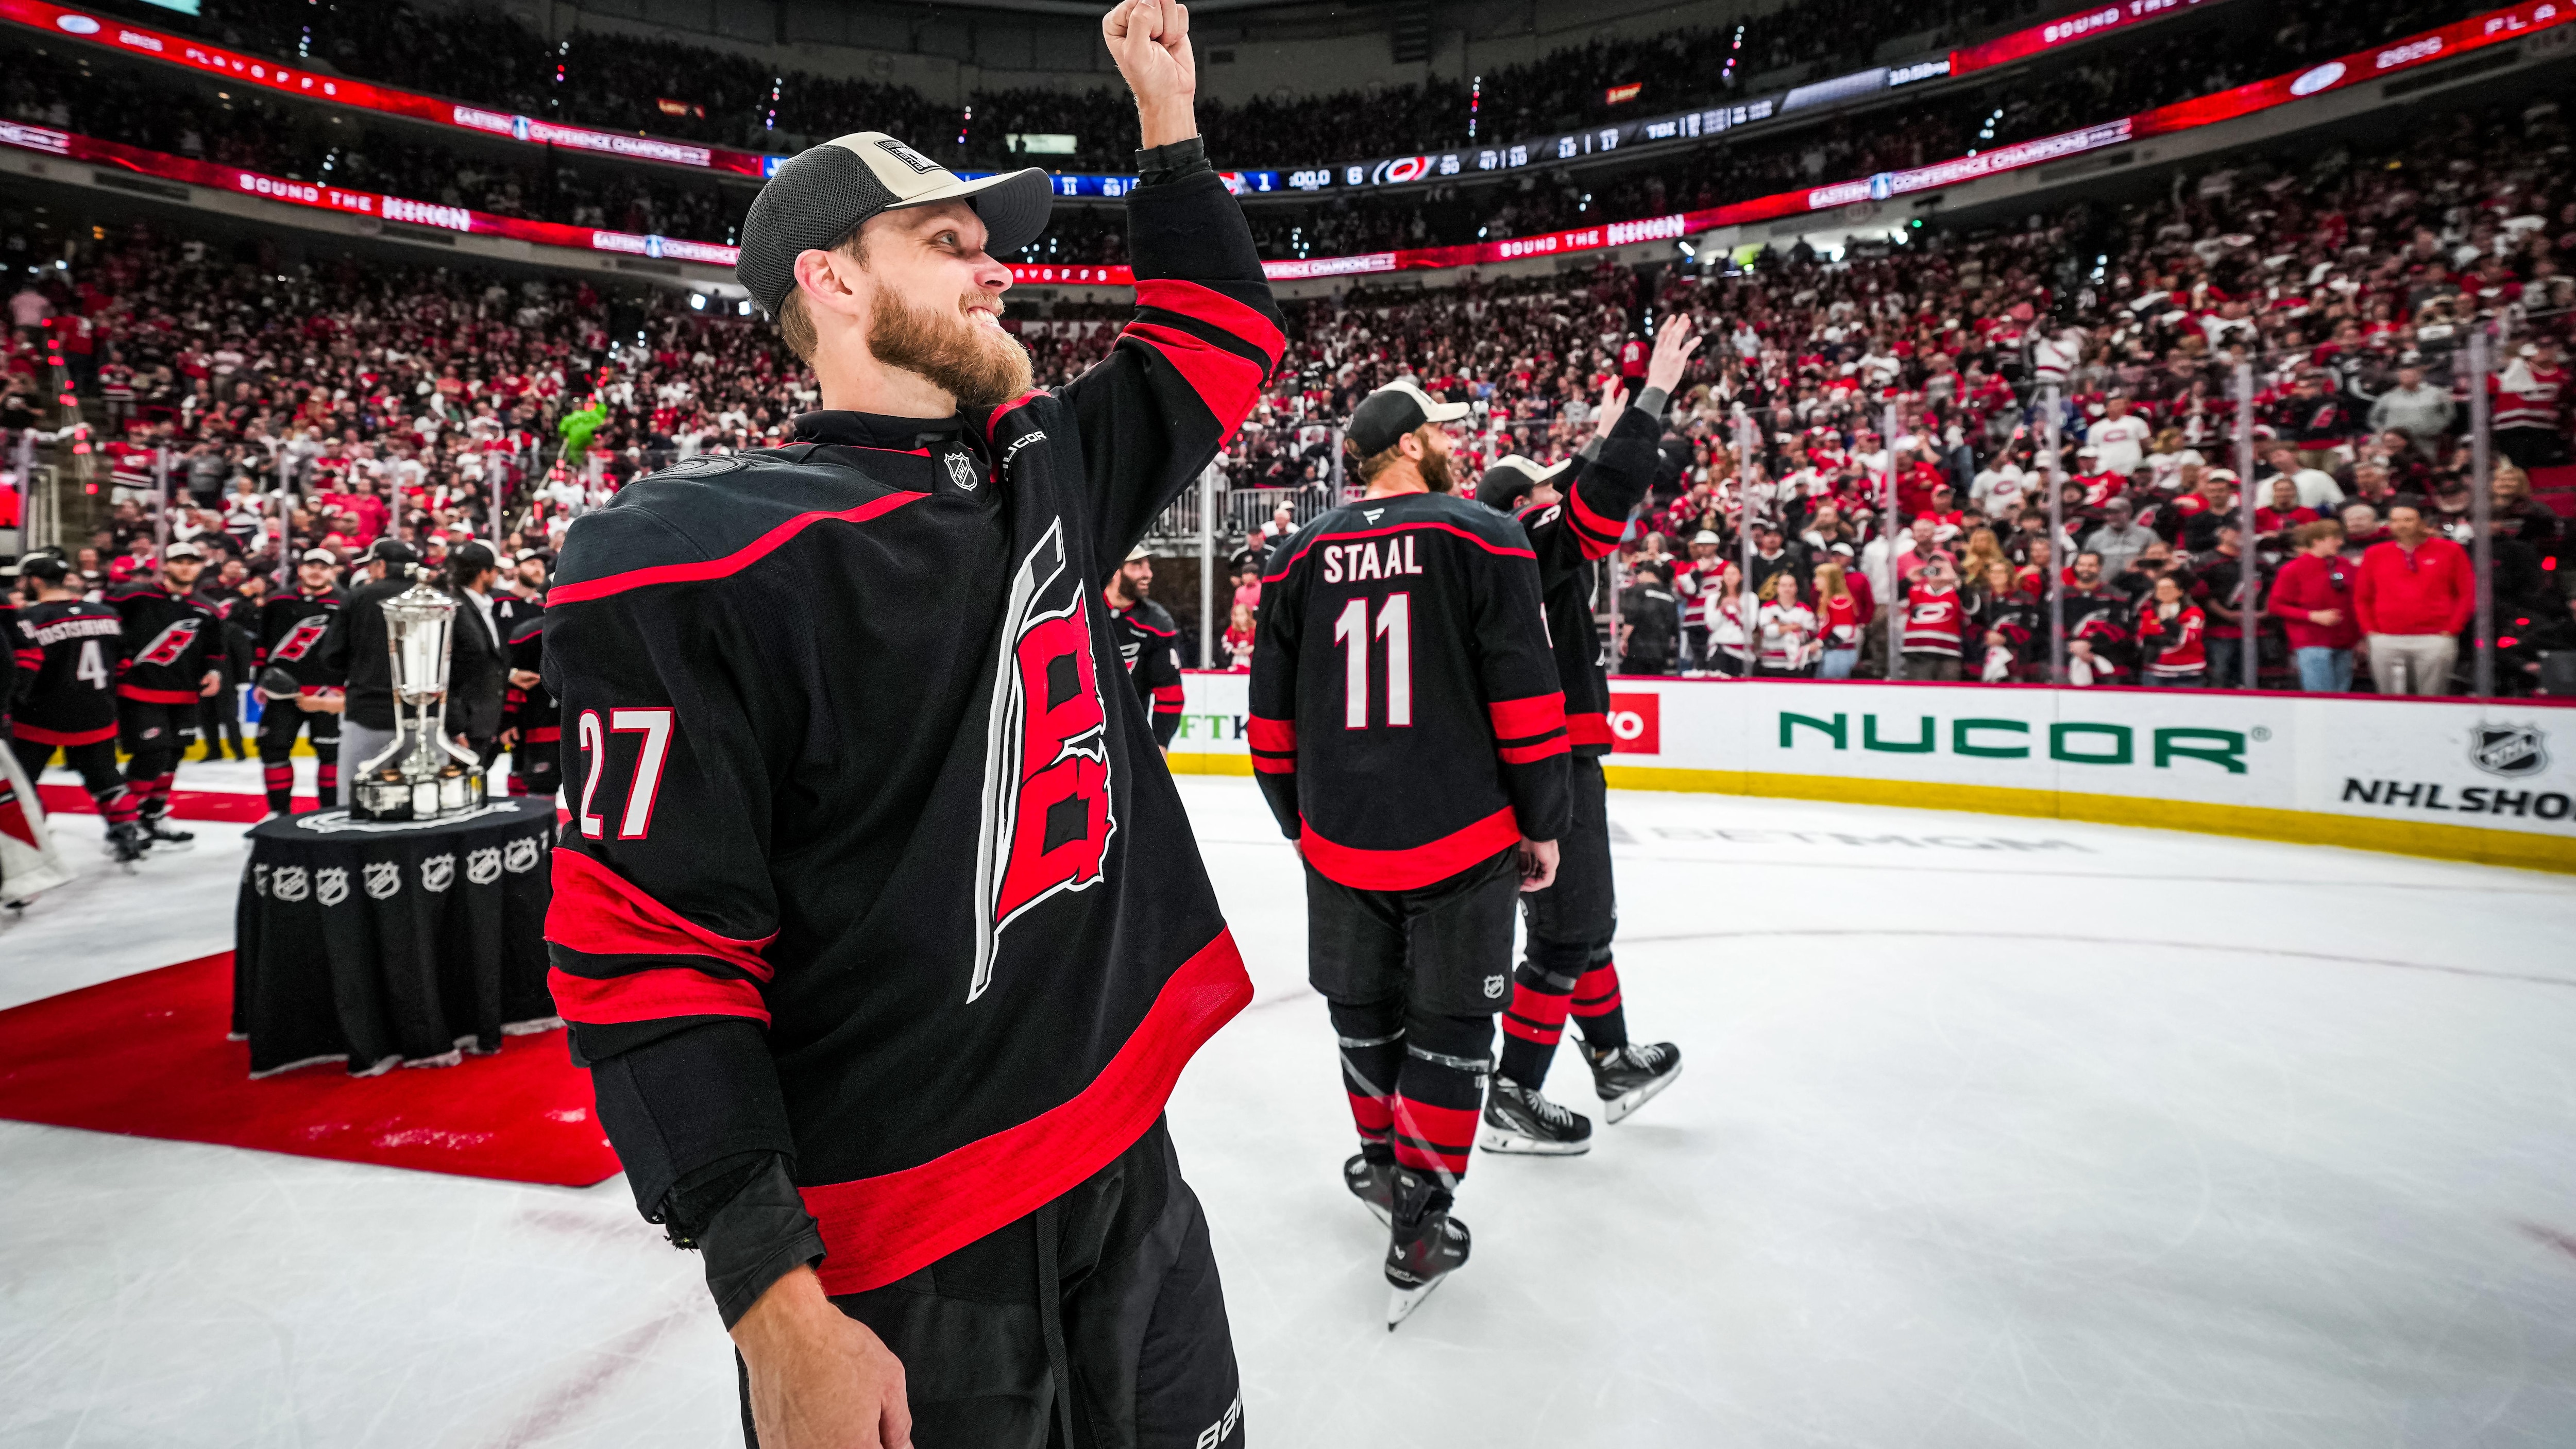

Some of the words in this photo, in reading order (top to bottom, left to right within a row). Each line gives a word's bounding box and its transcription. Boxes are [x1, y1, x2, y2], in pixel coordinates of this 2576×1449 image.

[240, 174, 318, 202] SOUND
[329, 190, 372, 212] THE
[1258, 174, 1271, 192] 1
[1347, 166, 1363, 185] 6
[1500, 236, 1557, 257] SOUND
[1565, 230, 1599, 247] THE
[956, 463, 969, 483] NHL
[1324, 535, 1423, 584] STAAL
[77, 640, 108, 690] 4
[1334, 591, 1413, 730] 11
[1780, 710, 2248, 774] NUCOR
[579, 707, 675, 840] 27
[2342, 778, 2576, 821] NHLSHO
[1651, 825, 2101, 854] BETMGM
